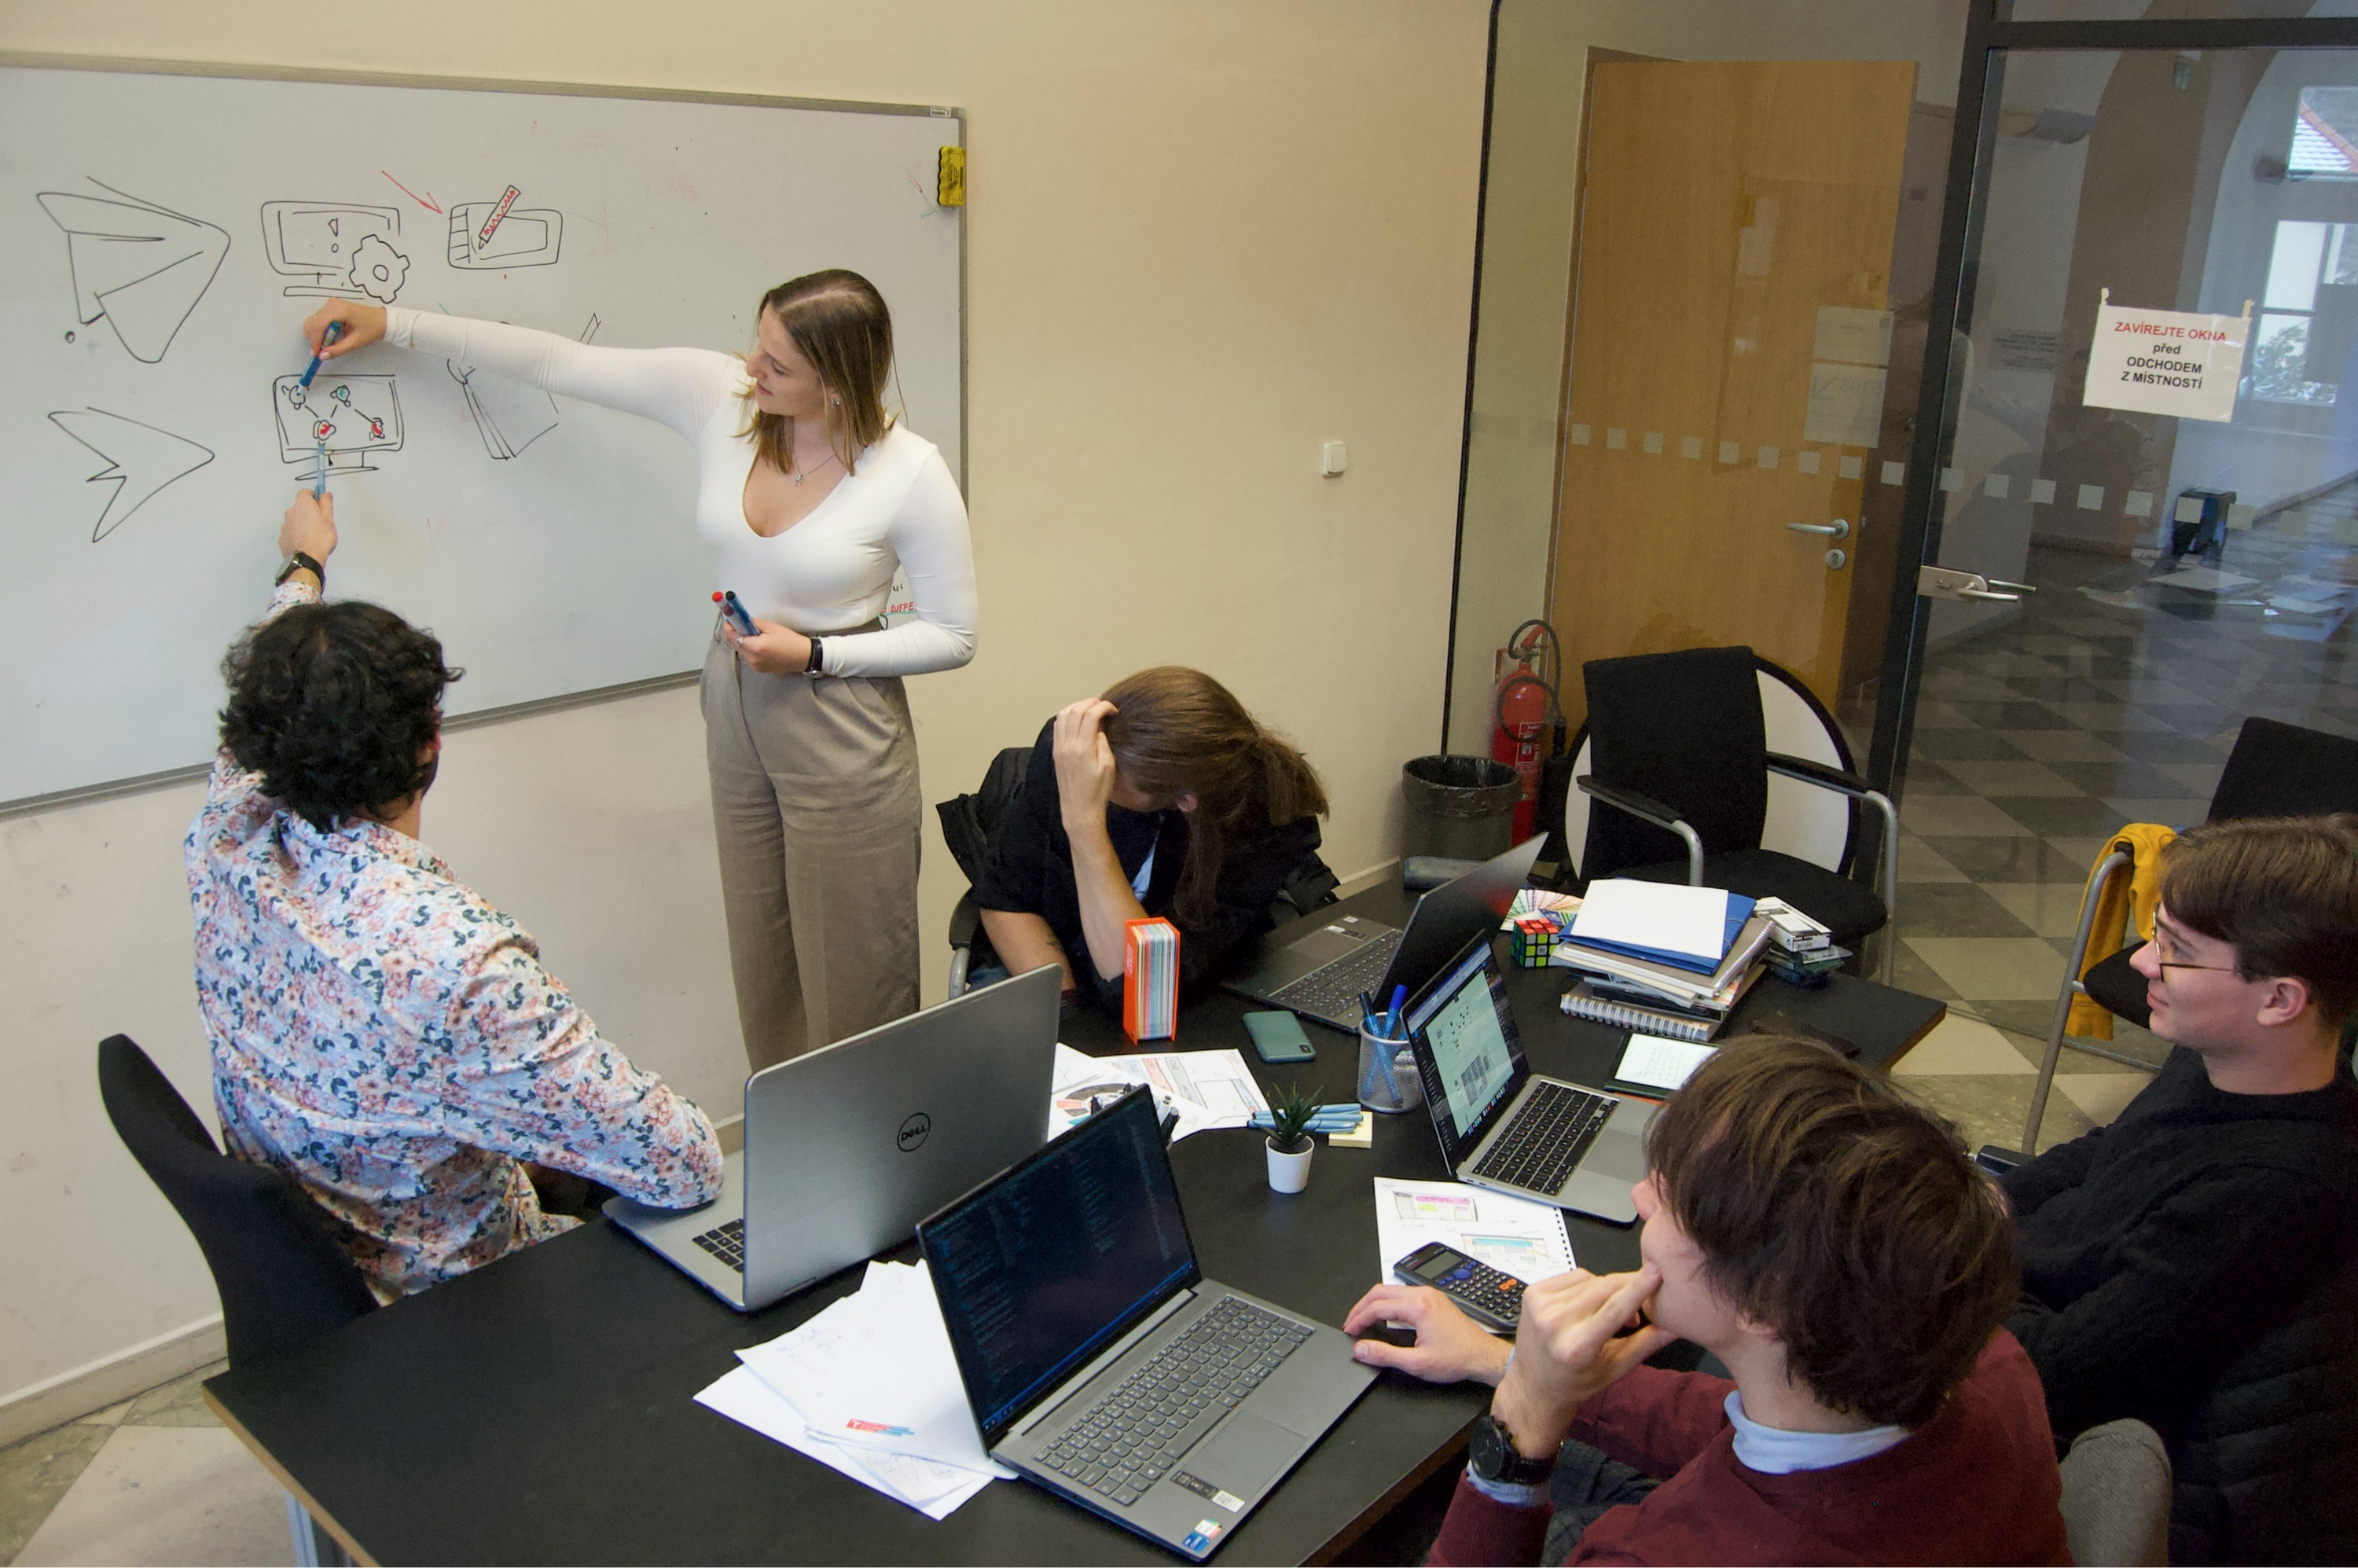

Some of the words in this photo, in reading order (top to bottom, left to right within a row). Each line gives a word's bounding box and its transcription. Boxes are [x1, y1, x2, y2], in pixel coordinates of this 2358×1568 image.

[2114, 321, 2185, 338] ZAVÍREJTE
[2188, 329, 2226, 341] OKNA
[2153, 343, 2180, 354] před
[2127, 357, 2202, 374] ODCHODEM
[2121, 372, 2129, 381] Z
[2132, 372, 2203, 389] MÍSTNOSTÍ
[901, 1123, 926, 1142] DELL
